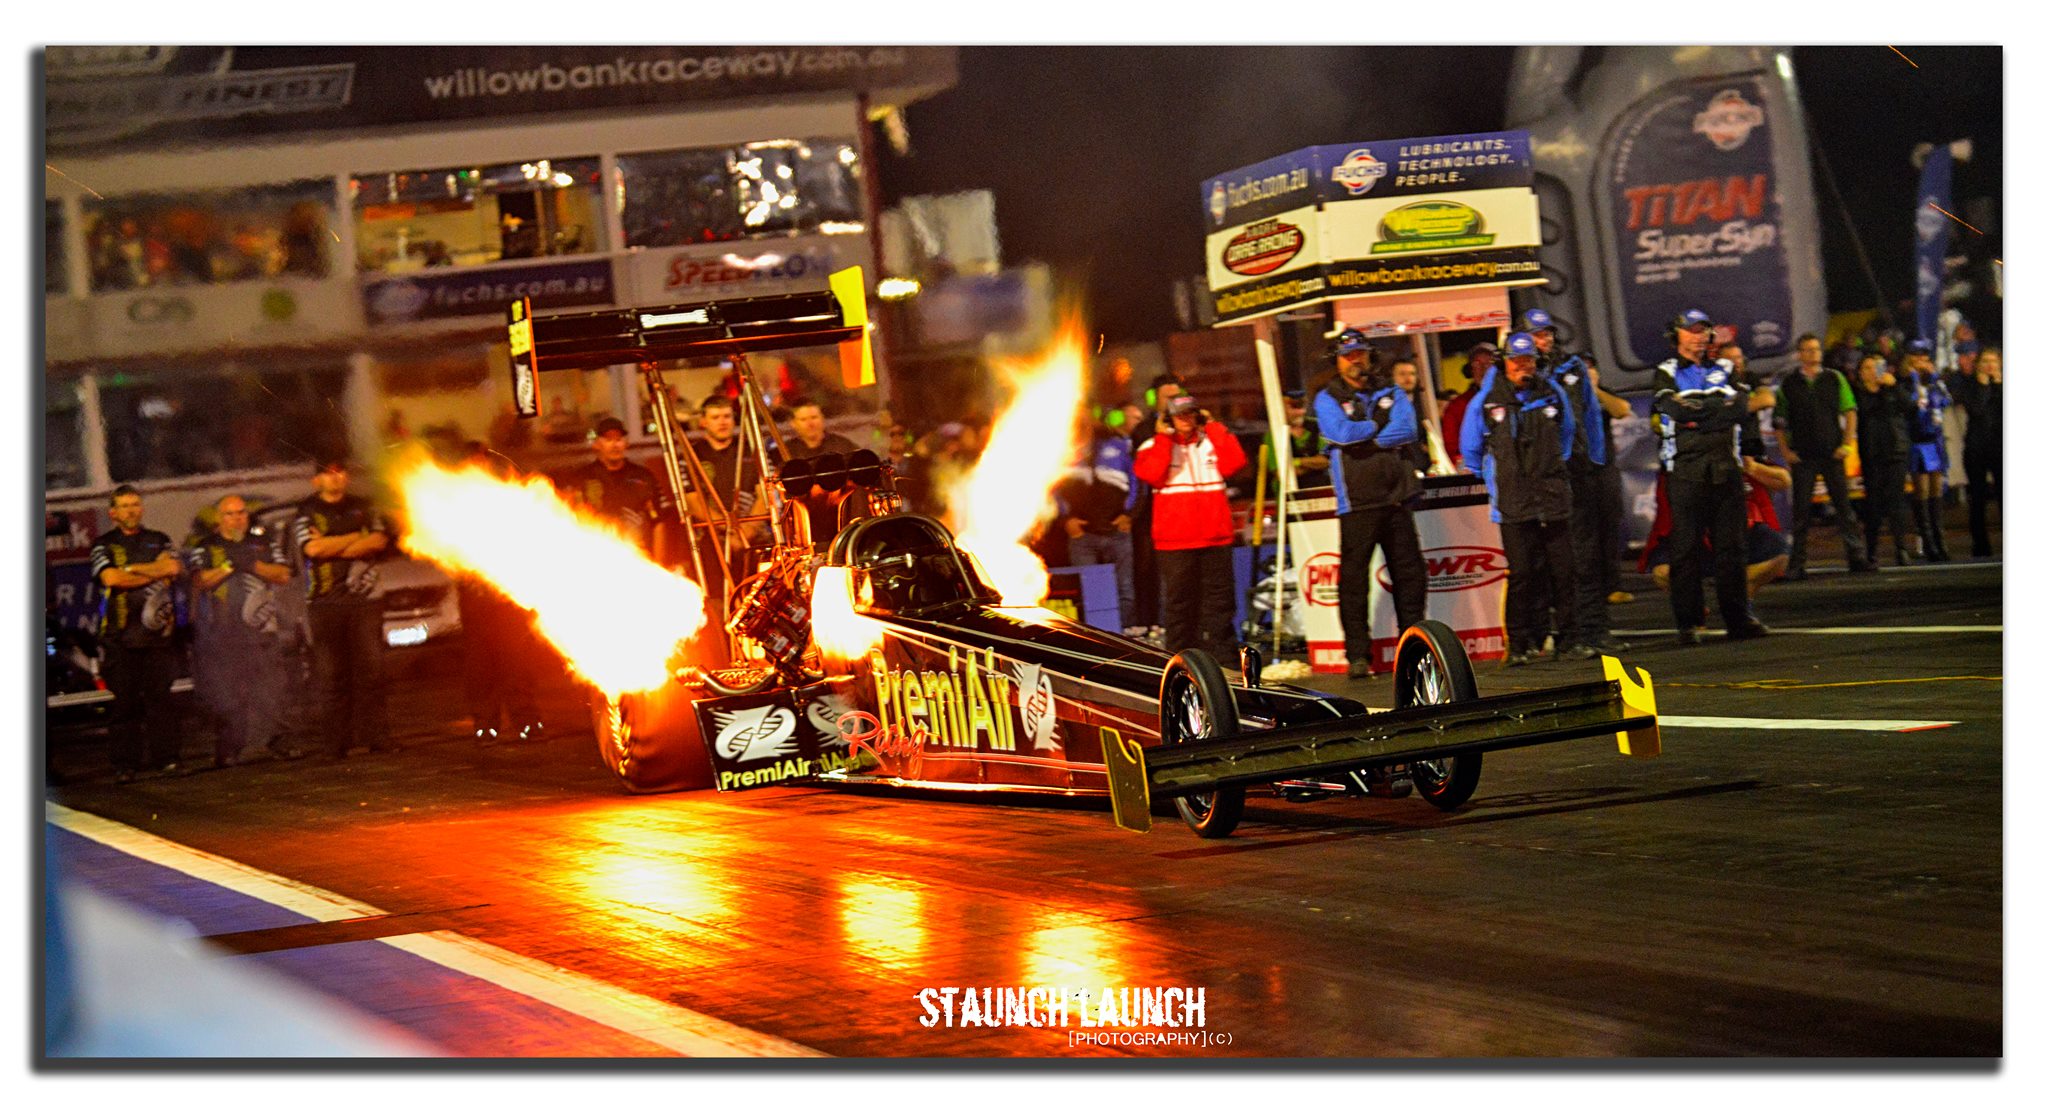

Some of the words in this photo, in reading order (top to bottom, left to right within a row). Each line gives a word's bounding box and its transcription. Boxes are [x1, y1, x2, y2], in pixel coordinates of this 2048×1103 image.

[1426, 553, 1497, 577] WR
[870, 644, 1016, 751] PremiAir
[720, 757, 811, 791] PremiAir
